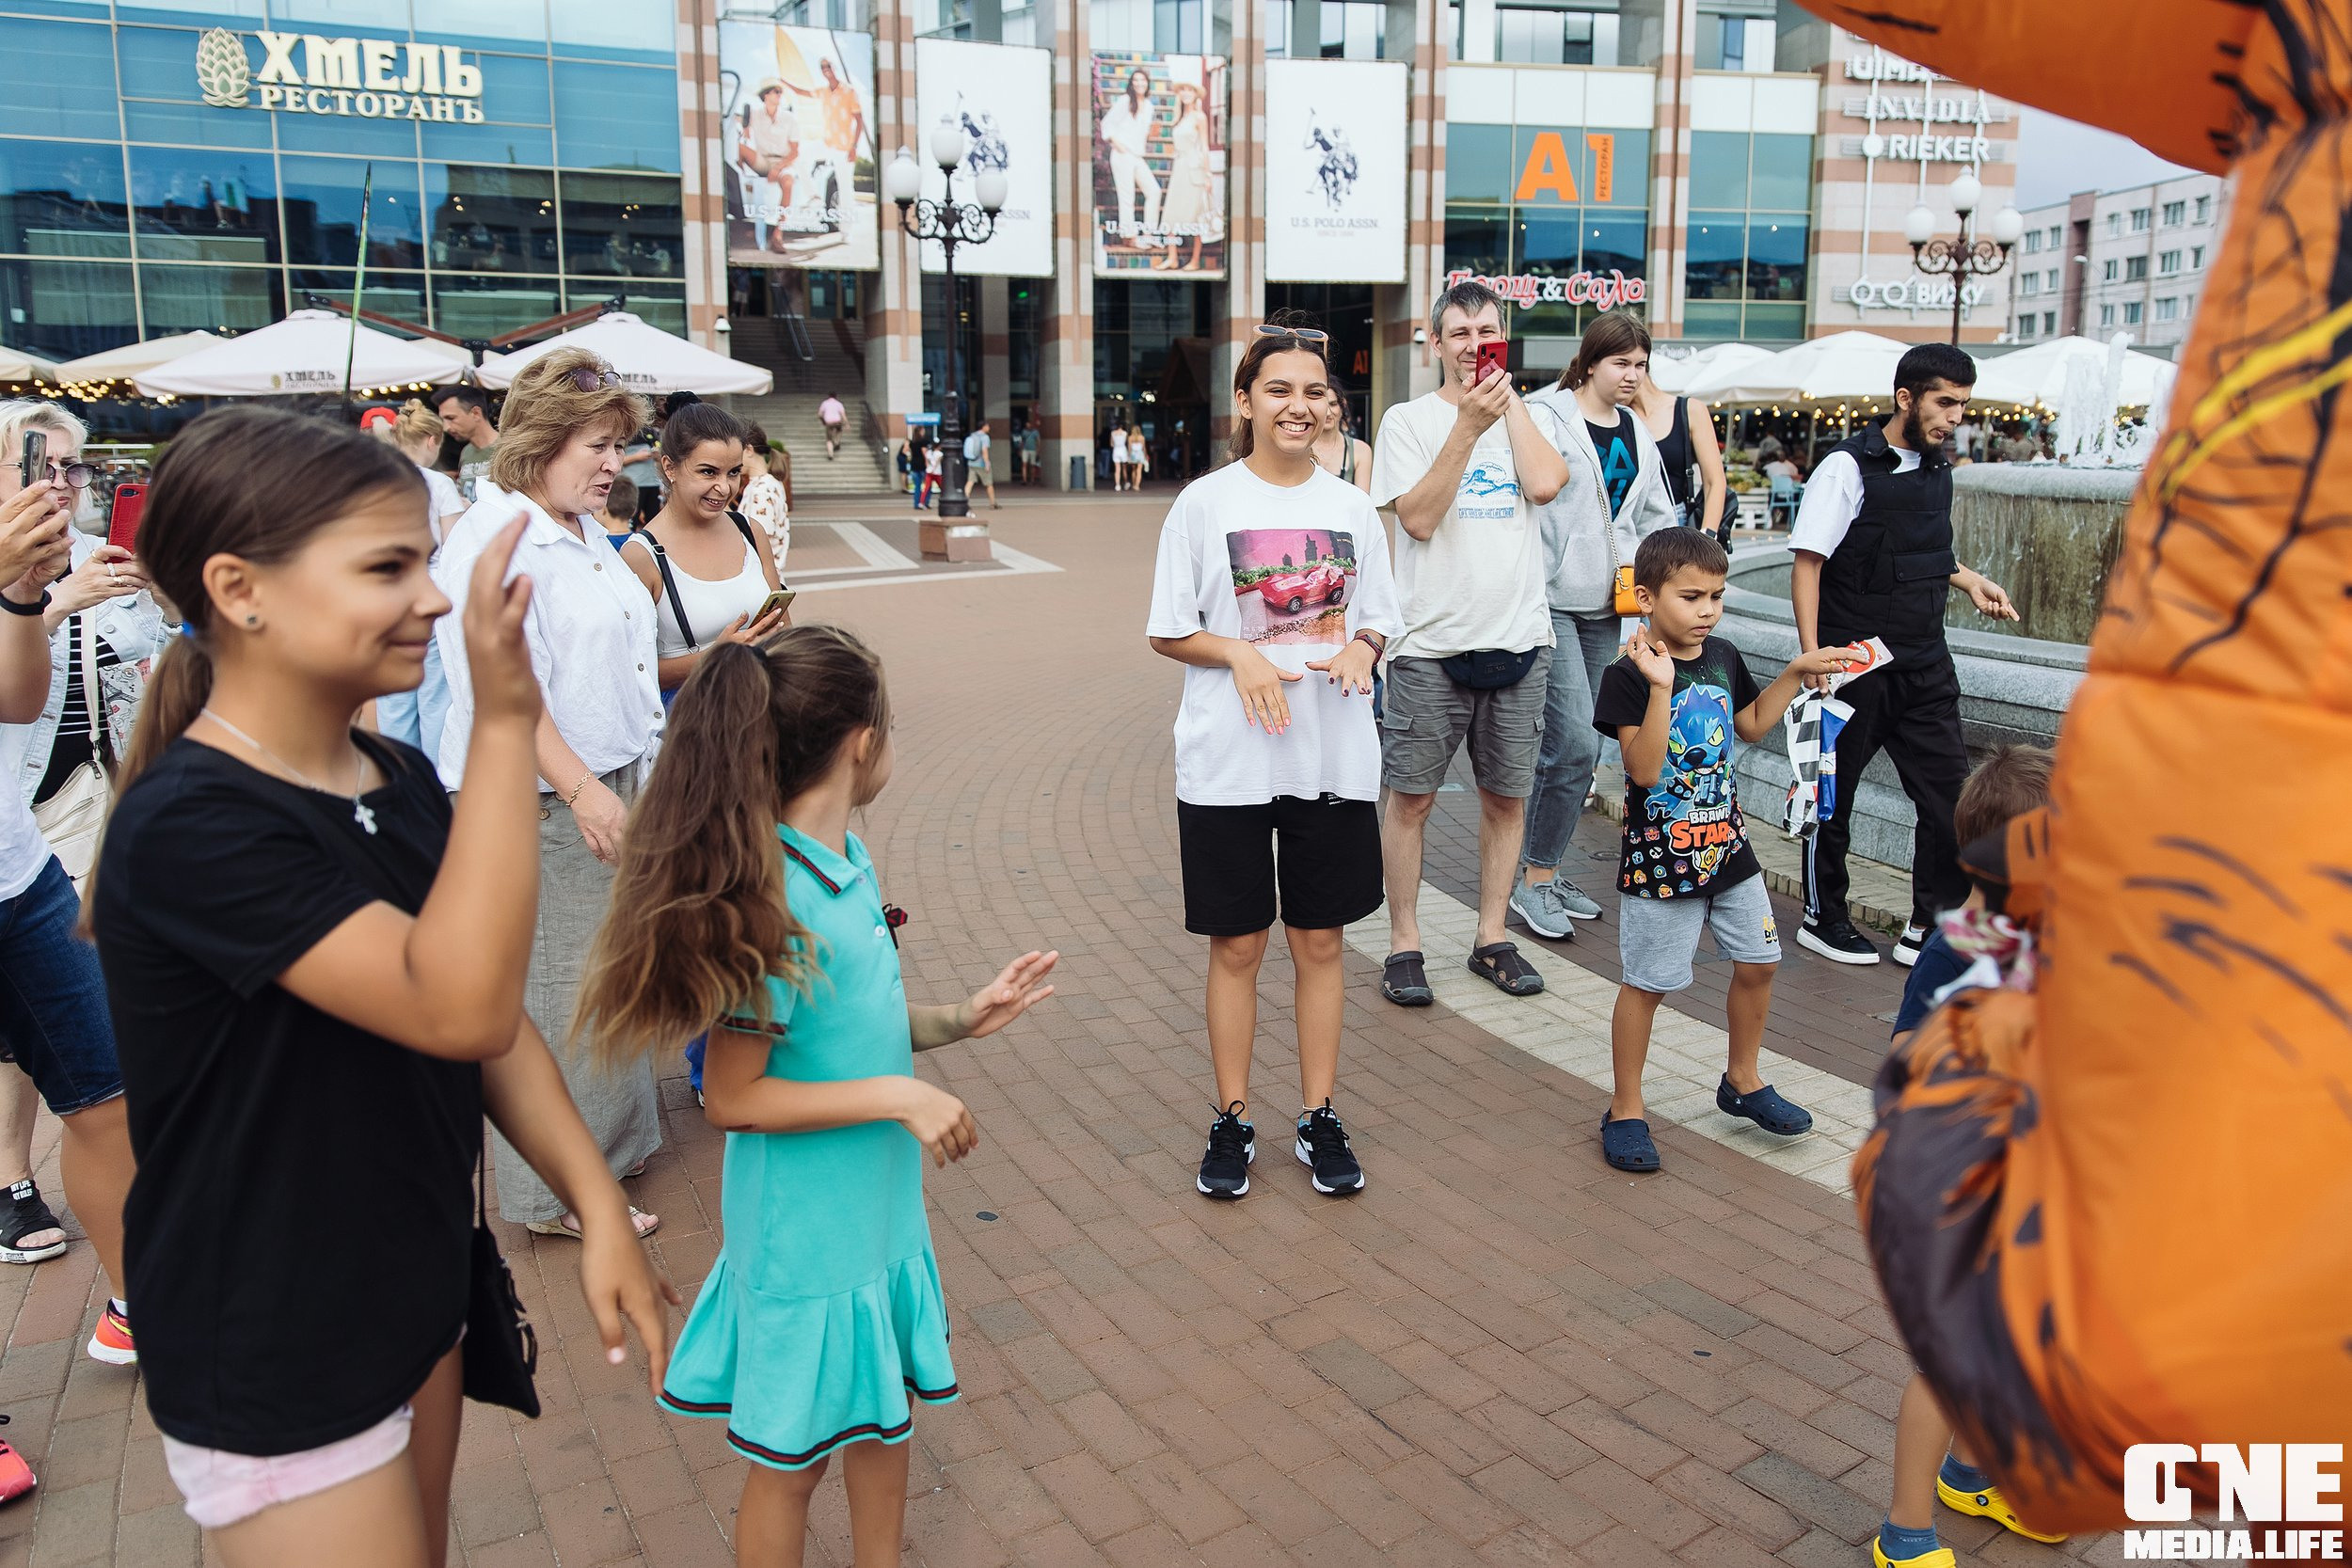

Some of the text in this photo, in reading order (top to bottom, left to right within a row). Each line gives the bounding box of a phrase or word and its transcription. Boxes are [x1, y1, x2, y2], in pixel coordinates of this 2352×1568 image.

[255, 30, 484, 98] ХМЕЛЬ
[259, 84, 485, 124] РЕСТОРАНЪ
[1888, 134, 1991, 163] RIEKER
[1314, 217, 1345, 228] POLO
[1543, 277, 1562, 302] &
[1565, 270, 1647, 312] Сало
[284, 371, 336, 382] ХМЕЛЬ
